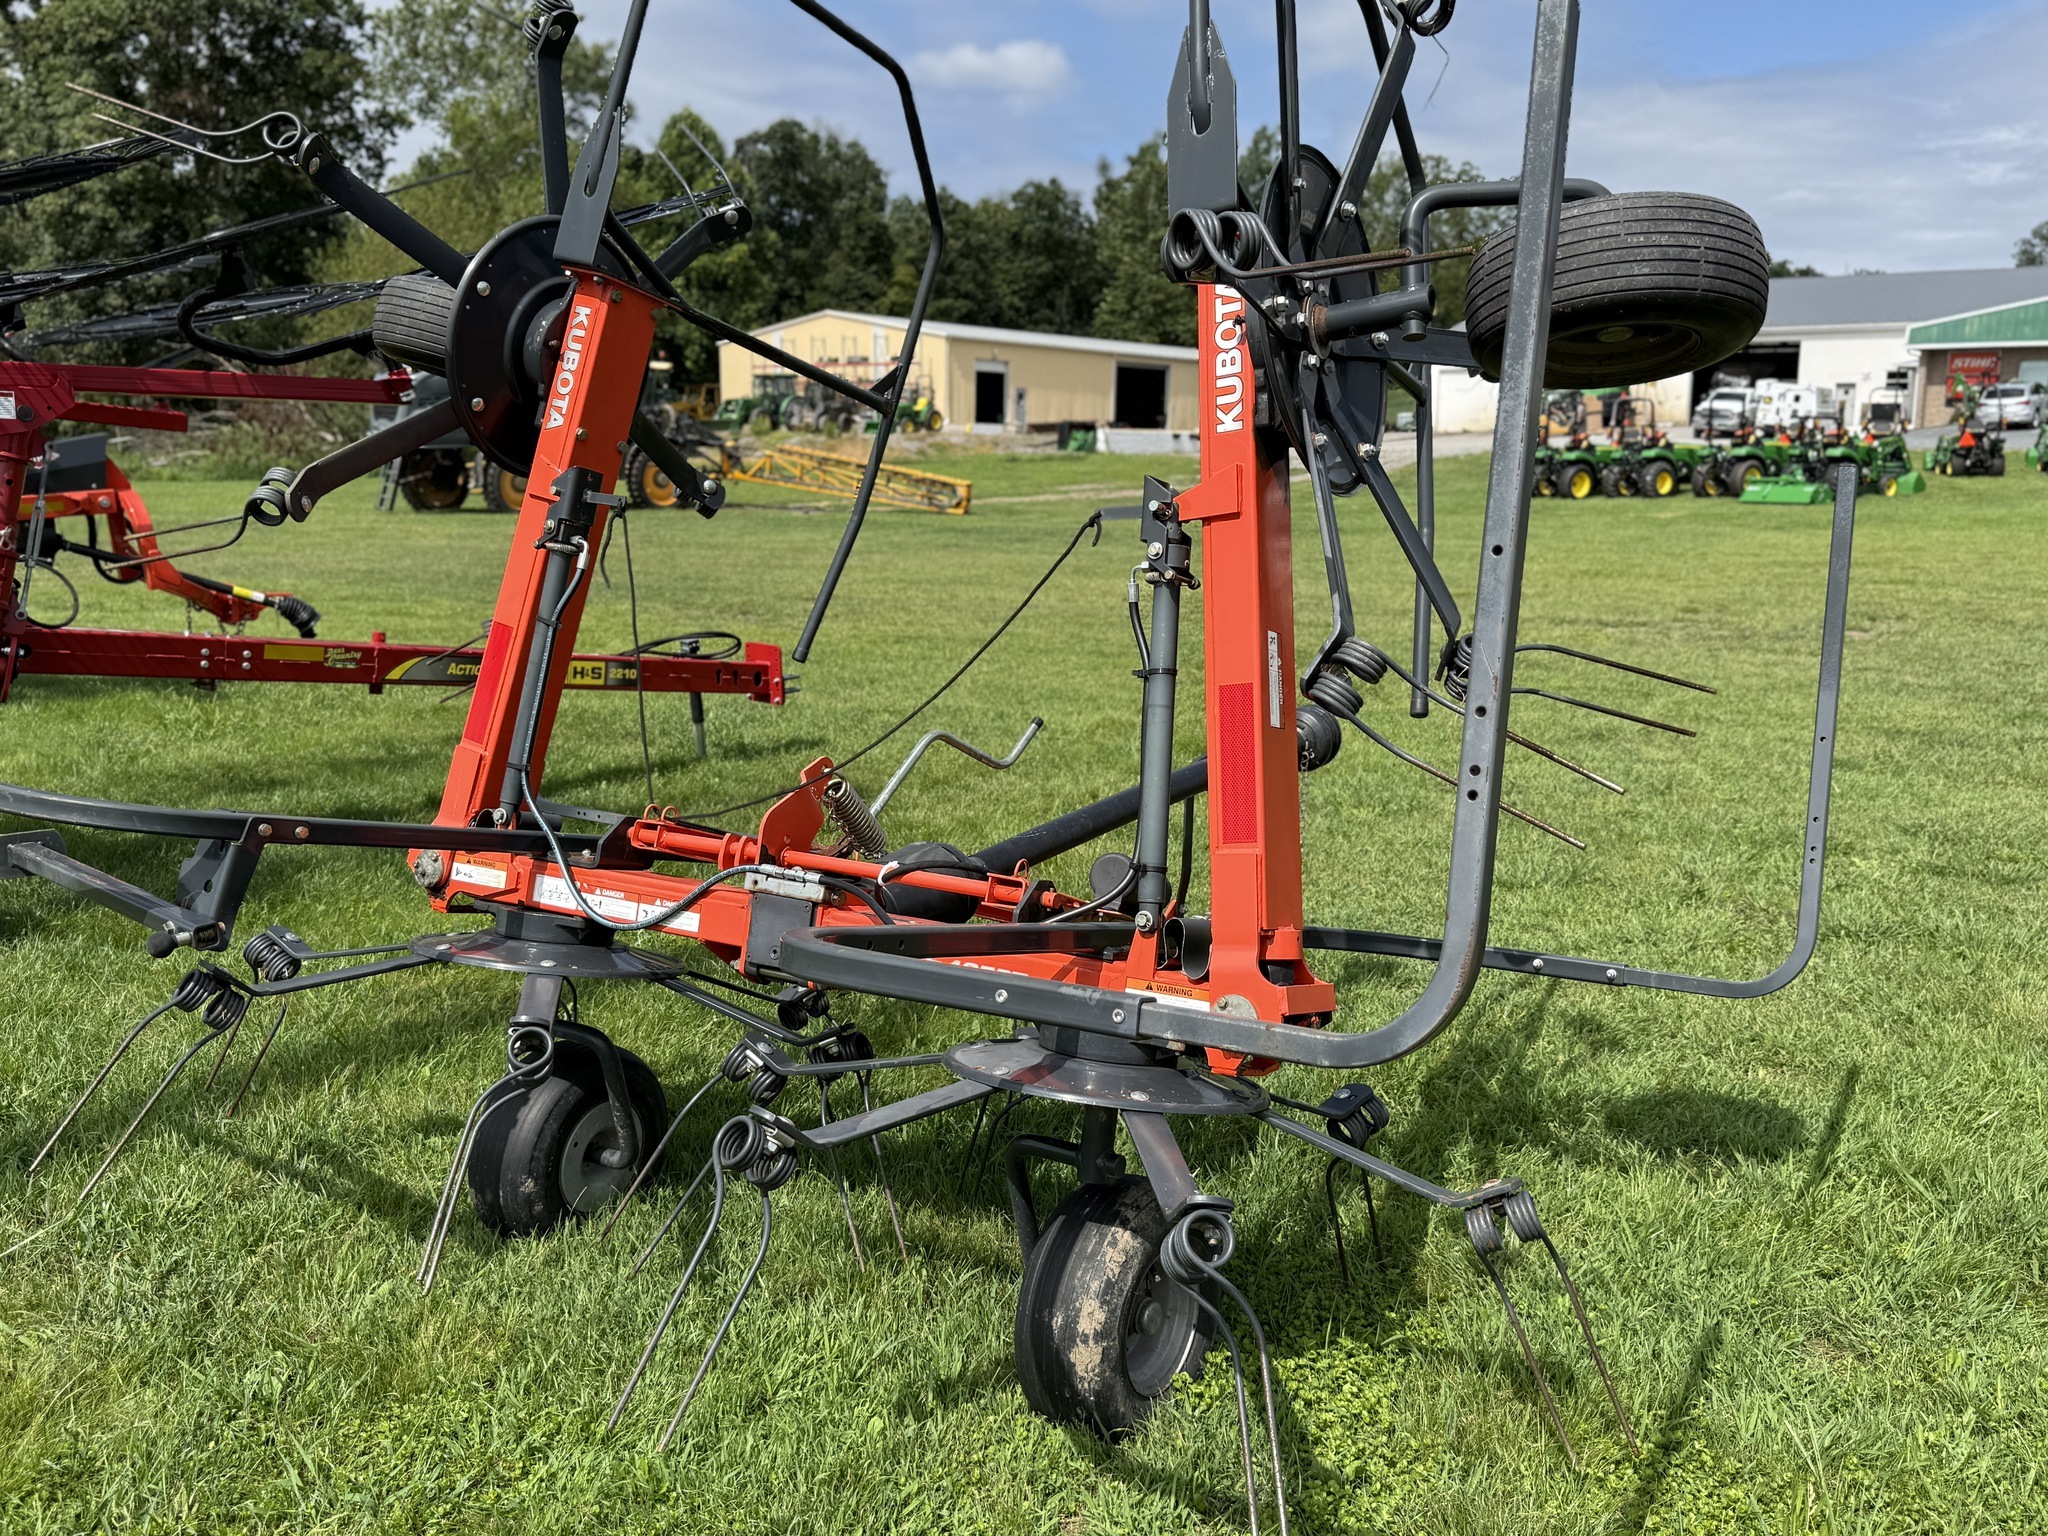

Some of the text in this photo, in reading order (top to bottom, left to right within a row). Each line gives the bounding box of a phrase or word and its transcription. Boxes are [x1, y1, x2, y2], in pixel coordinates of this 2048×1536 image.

[546, 306, 591, 430] KUBOTA
[328, 650, 362, 666] Country
[446, 662, 481, 676] ACTIO
[572, 666, 637, 680] H&S 2210
[472, 858, 496, 869] WARNING
[602, 889, 624, 899] DANGER
[1156, 984, 1193, 997] WARNING
